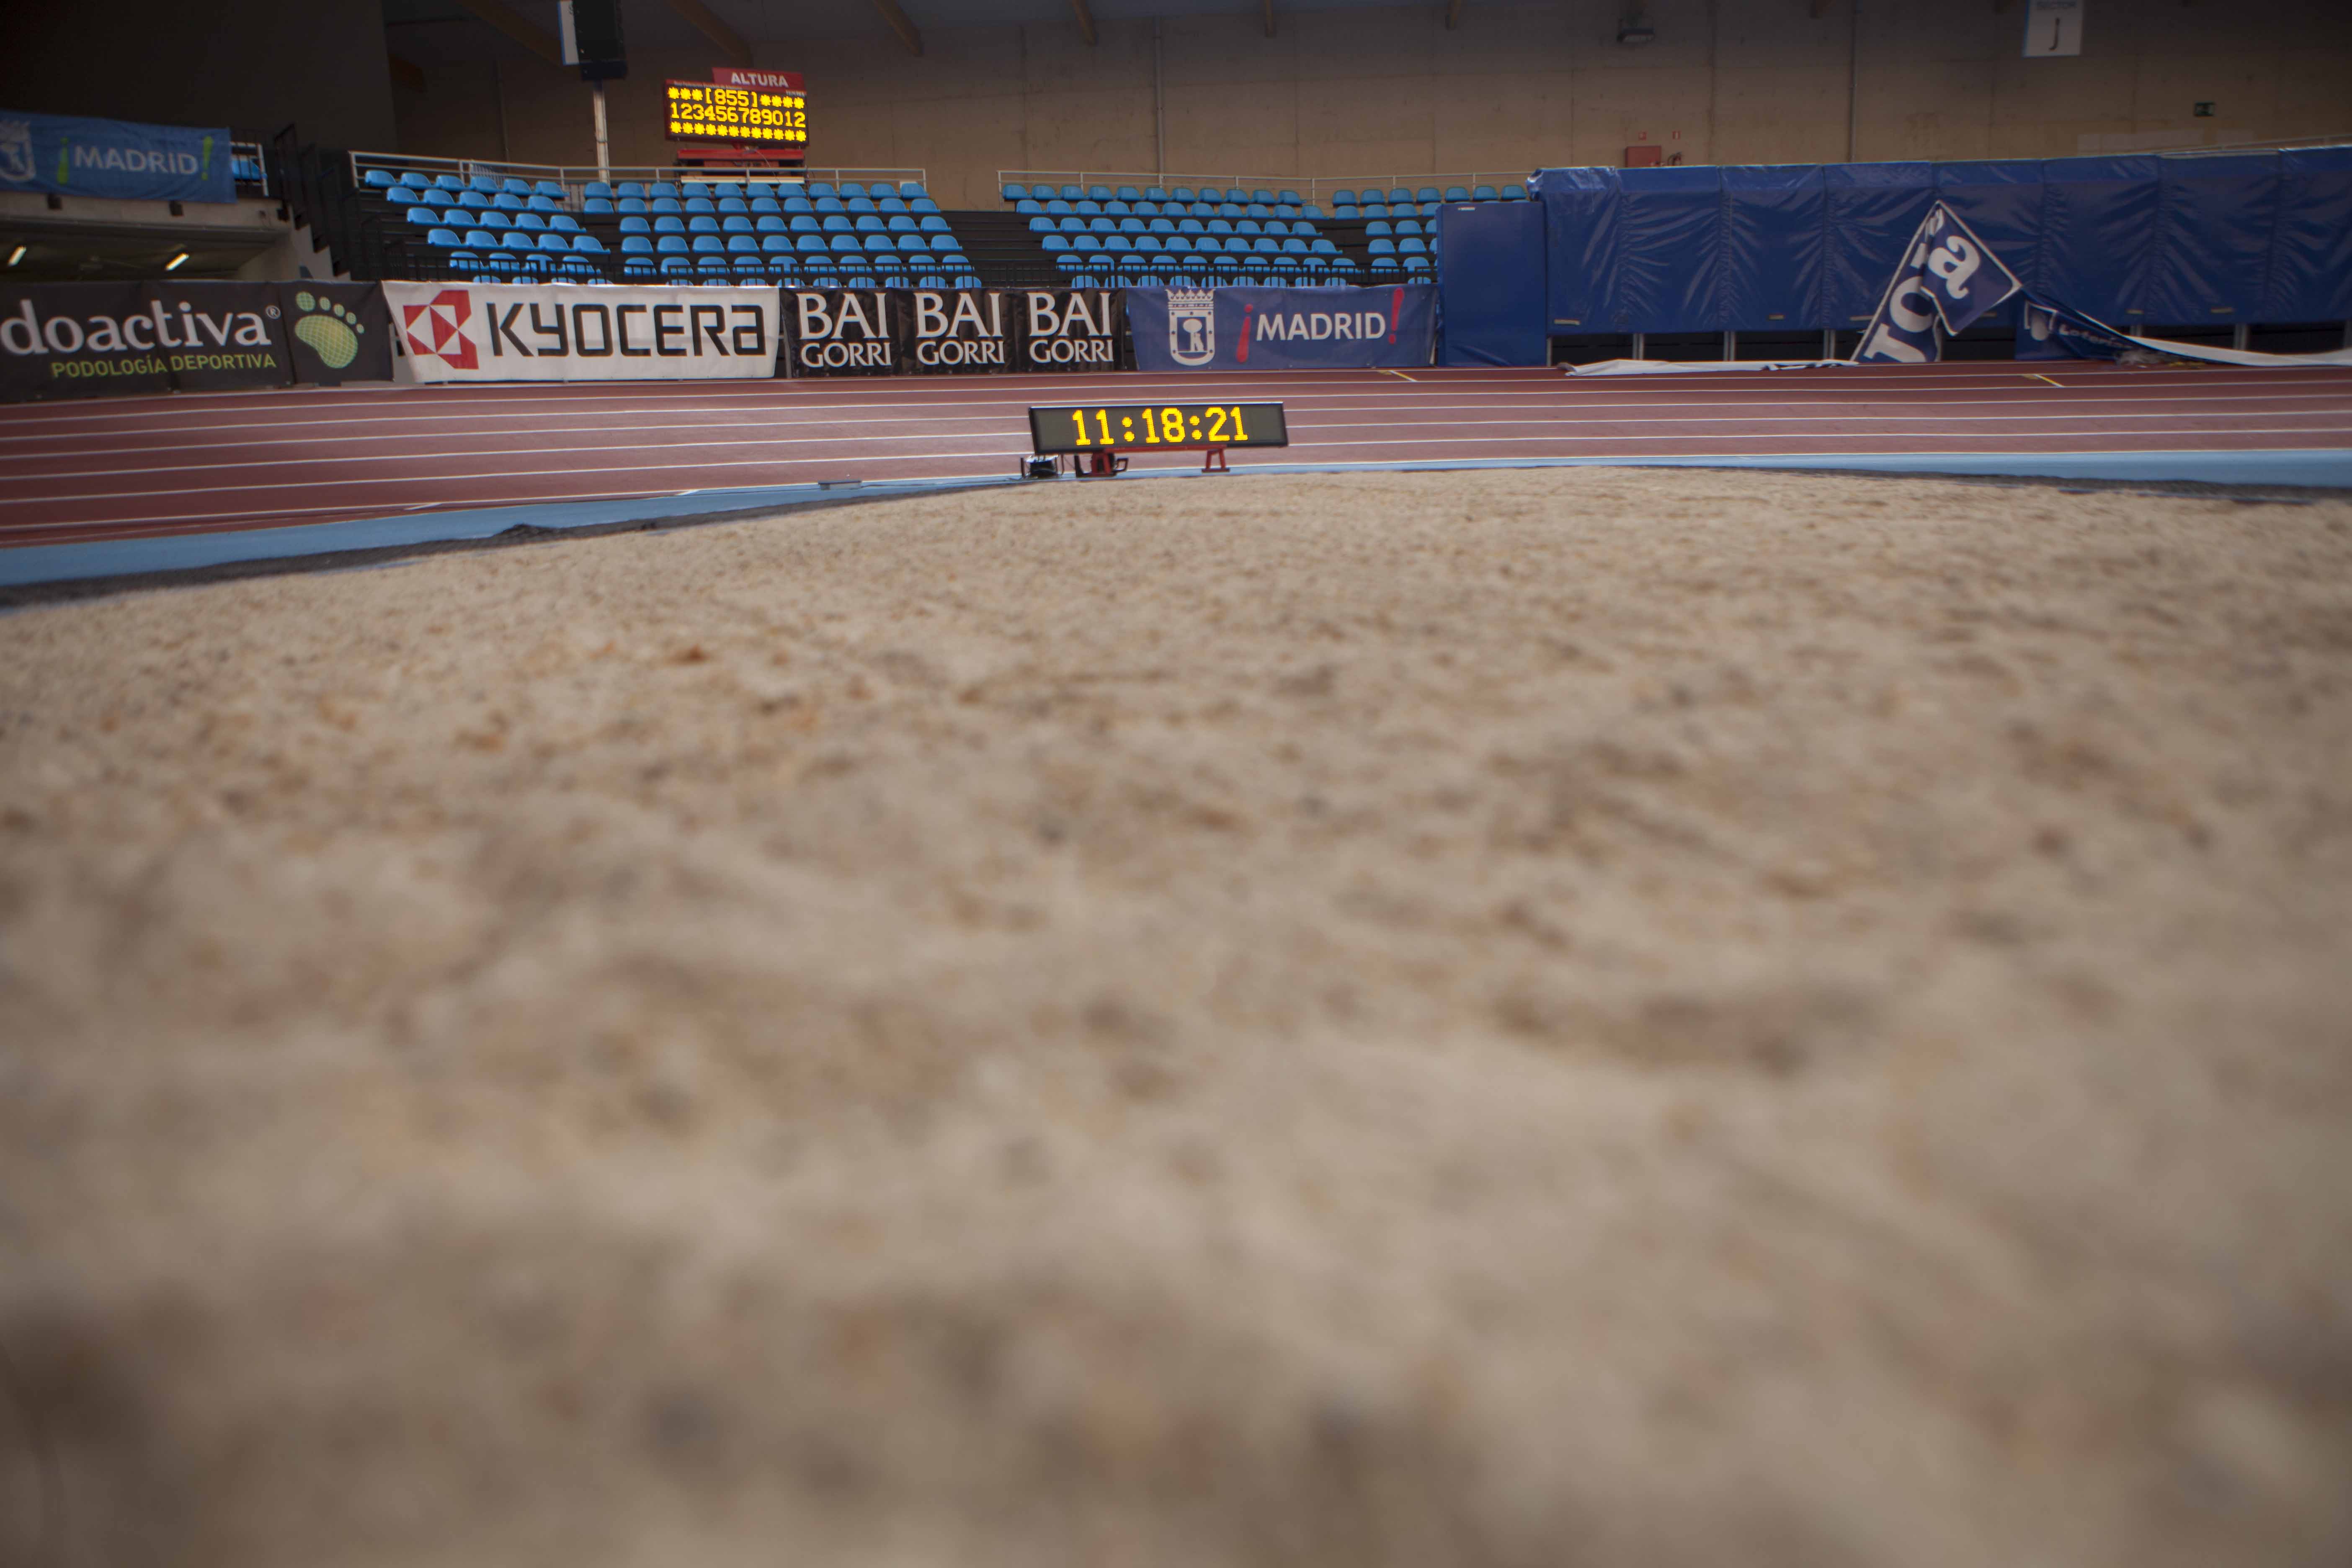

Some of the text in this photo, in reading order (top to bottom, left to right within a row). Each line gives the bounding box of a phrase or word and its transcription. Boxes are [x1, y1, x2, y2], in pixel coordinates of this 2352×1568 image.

[2049, 17, 2060, 51] J
[731, 72, 789, 88] ALTURA
[671, 102, 806, 128] 123456789012
[487, 302, 767, 357] KYOCERA
[797, 292, 890, 340] BAI
[913, 292, 1004, 338] BAI
[1027, 292, 1112, 337] BAI
[51, 353, 276, 378] PODOLOGÍA DEPORTIVA
[801, 342, 892, 368] GORRI
[917, 340, 1005, 366] GORRI
[1029, 339, 1114, 364] GORRI
[1072, 406, 1248, 446] 11:18:21
